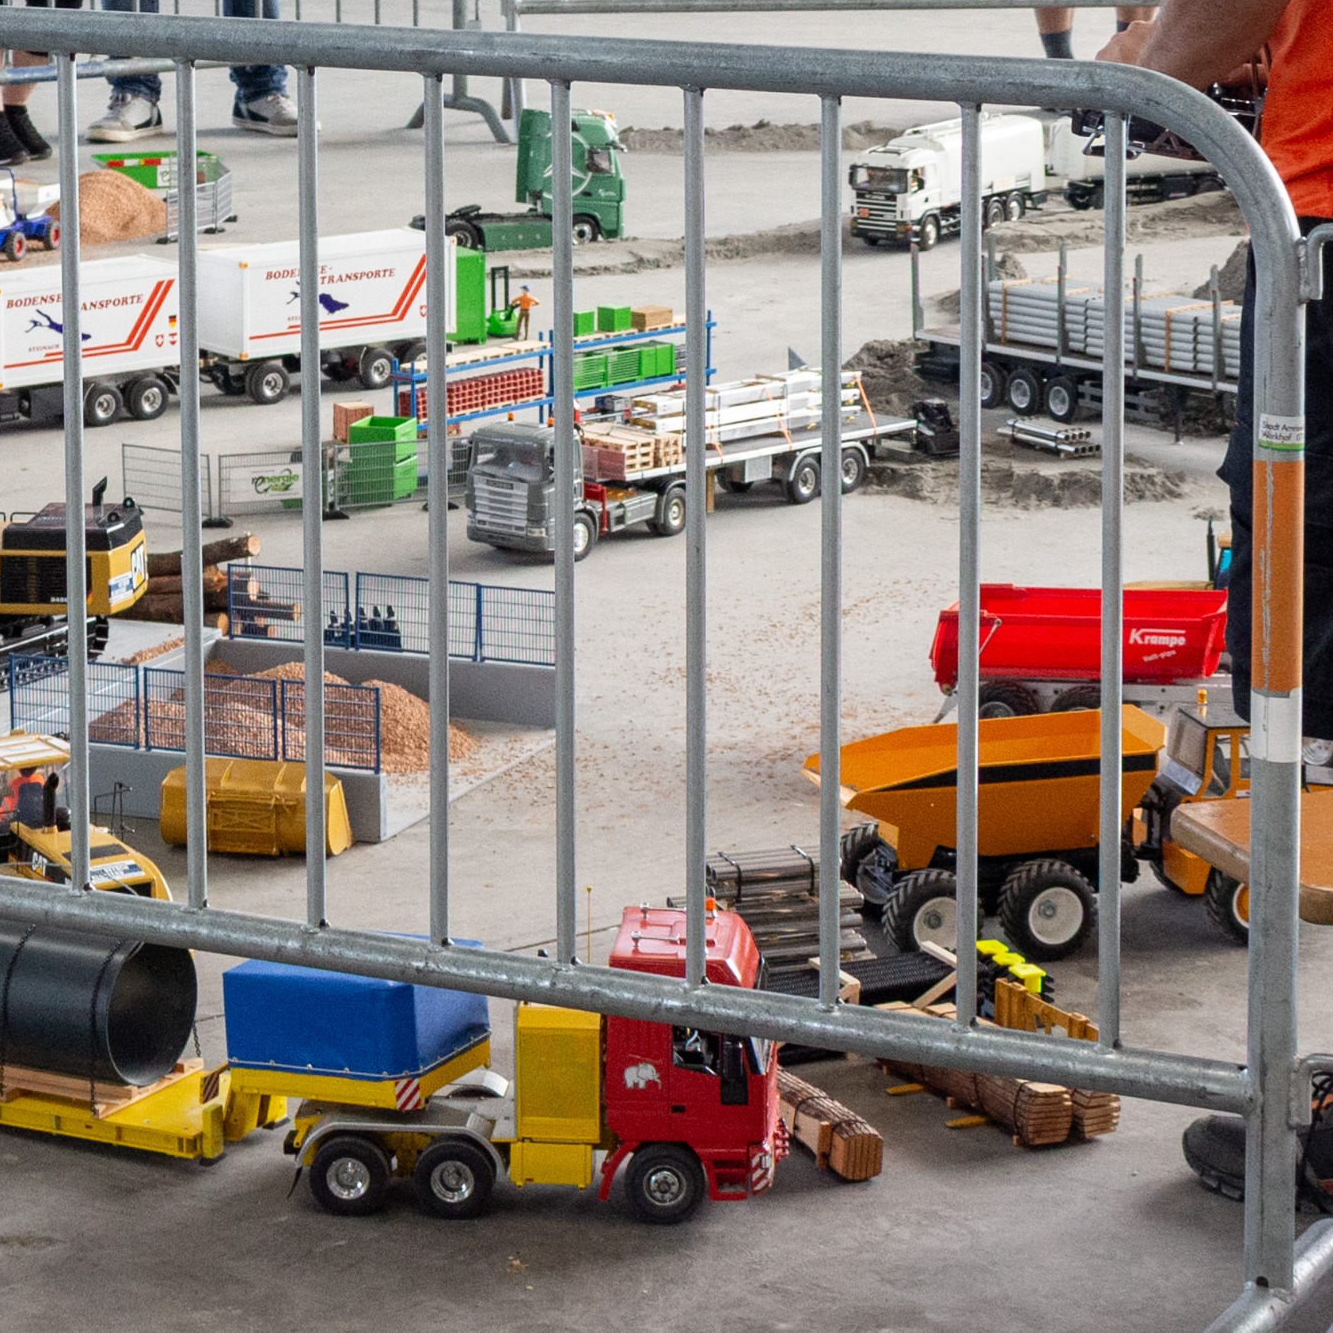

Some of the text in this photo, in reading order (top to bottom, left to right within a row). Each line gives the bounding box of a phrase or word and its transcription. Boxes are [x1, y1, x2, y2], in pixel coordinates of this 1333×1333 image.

[320, 268, 396, 285] TRANSPORTE
[6, 293, 63, 309] BODENSE
[80, 293, 144, 312] ANSPORTE
[1129, 628, 1186, 647] Krampe
[31, 851, 48, 876] CAT
